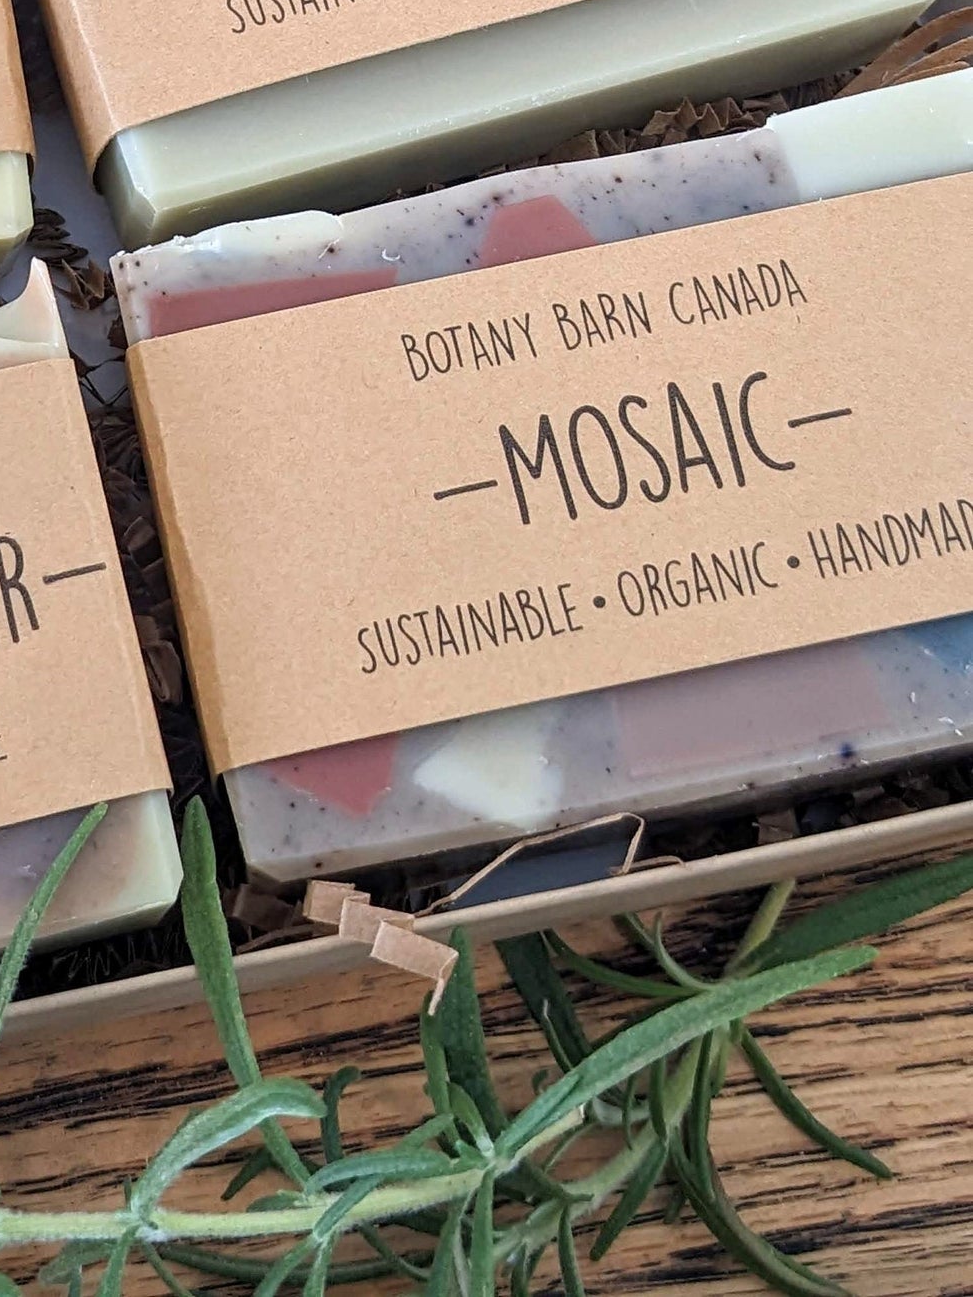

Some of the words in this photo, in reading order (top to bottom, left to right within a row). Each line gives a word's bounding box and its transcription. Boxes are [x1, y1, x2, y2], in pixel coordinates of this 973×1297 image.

[400, 312, 538, 382] BOTANY
[551, 291, 652, 351] BARN
[668, 258, 808, 325] CANADA
[357, 582, 584, 675] SUSTAINABLE
[617, 541, 779, 617] ORGANIC
